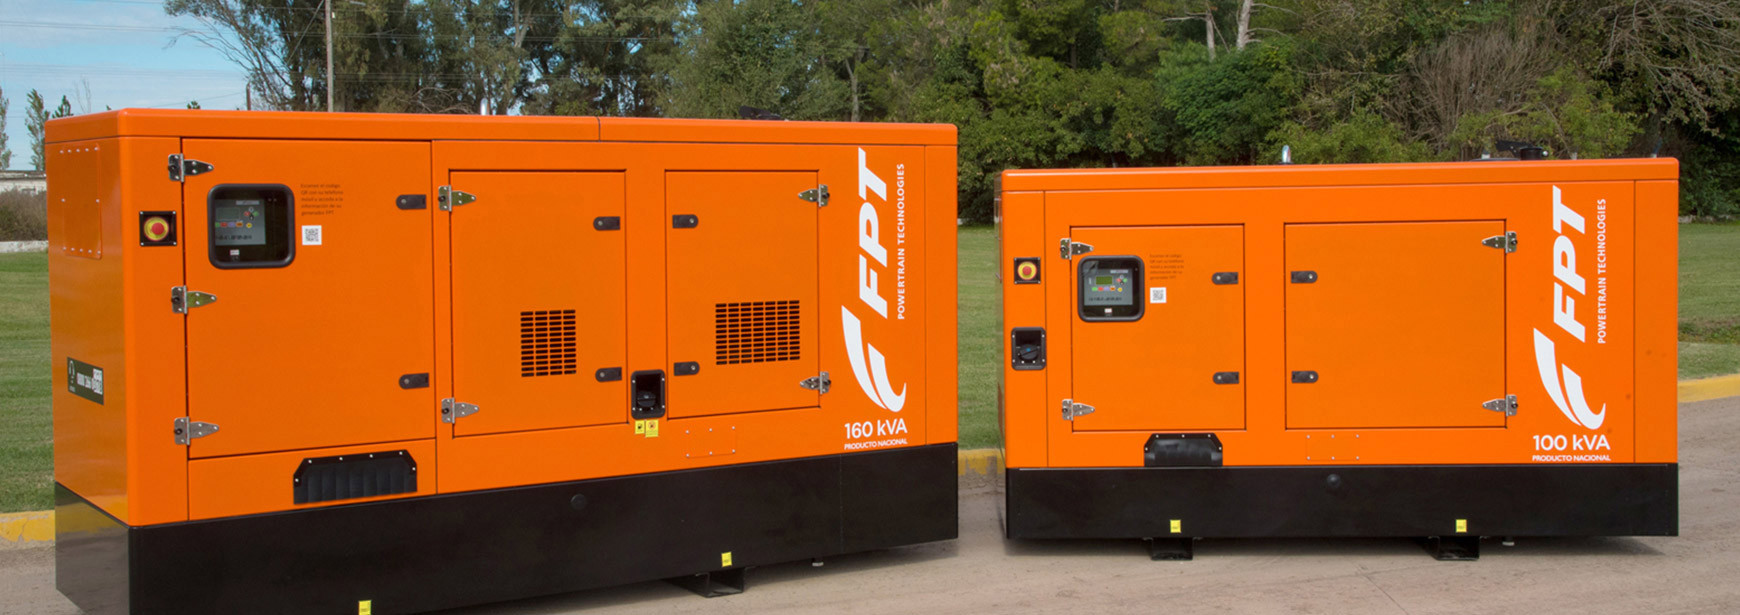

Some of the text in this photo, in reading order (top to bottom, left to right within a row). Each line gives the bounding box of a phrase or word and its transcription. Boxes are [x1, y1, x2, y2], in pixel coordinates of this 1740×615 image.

[858, 147, 887, 319] FPT
[897, 163, 905, 320] POWERTRAIN TECHNOLOGIES
[1552, 185, 1585, 343] FPT
[1597, 199, 1606, 344] POWERTRAIN TECHNOLOGIES
[844, 418, 908, 440] 160 kVA
[844, 438, 908, 450] PRODUCTO NACIONAL
[1532, 434, 1611, 451] 100 kVA
[1532, 454, 1611, 462] PRODUCTO NACIONAL
